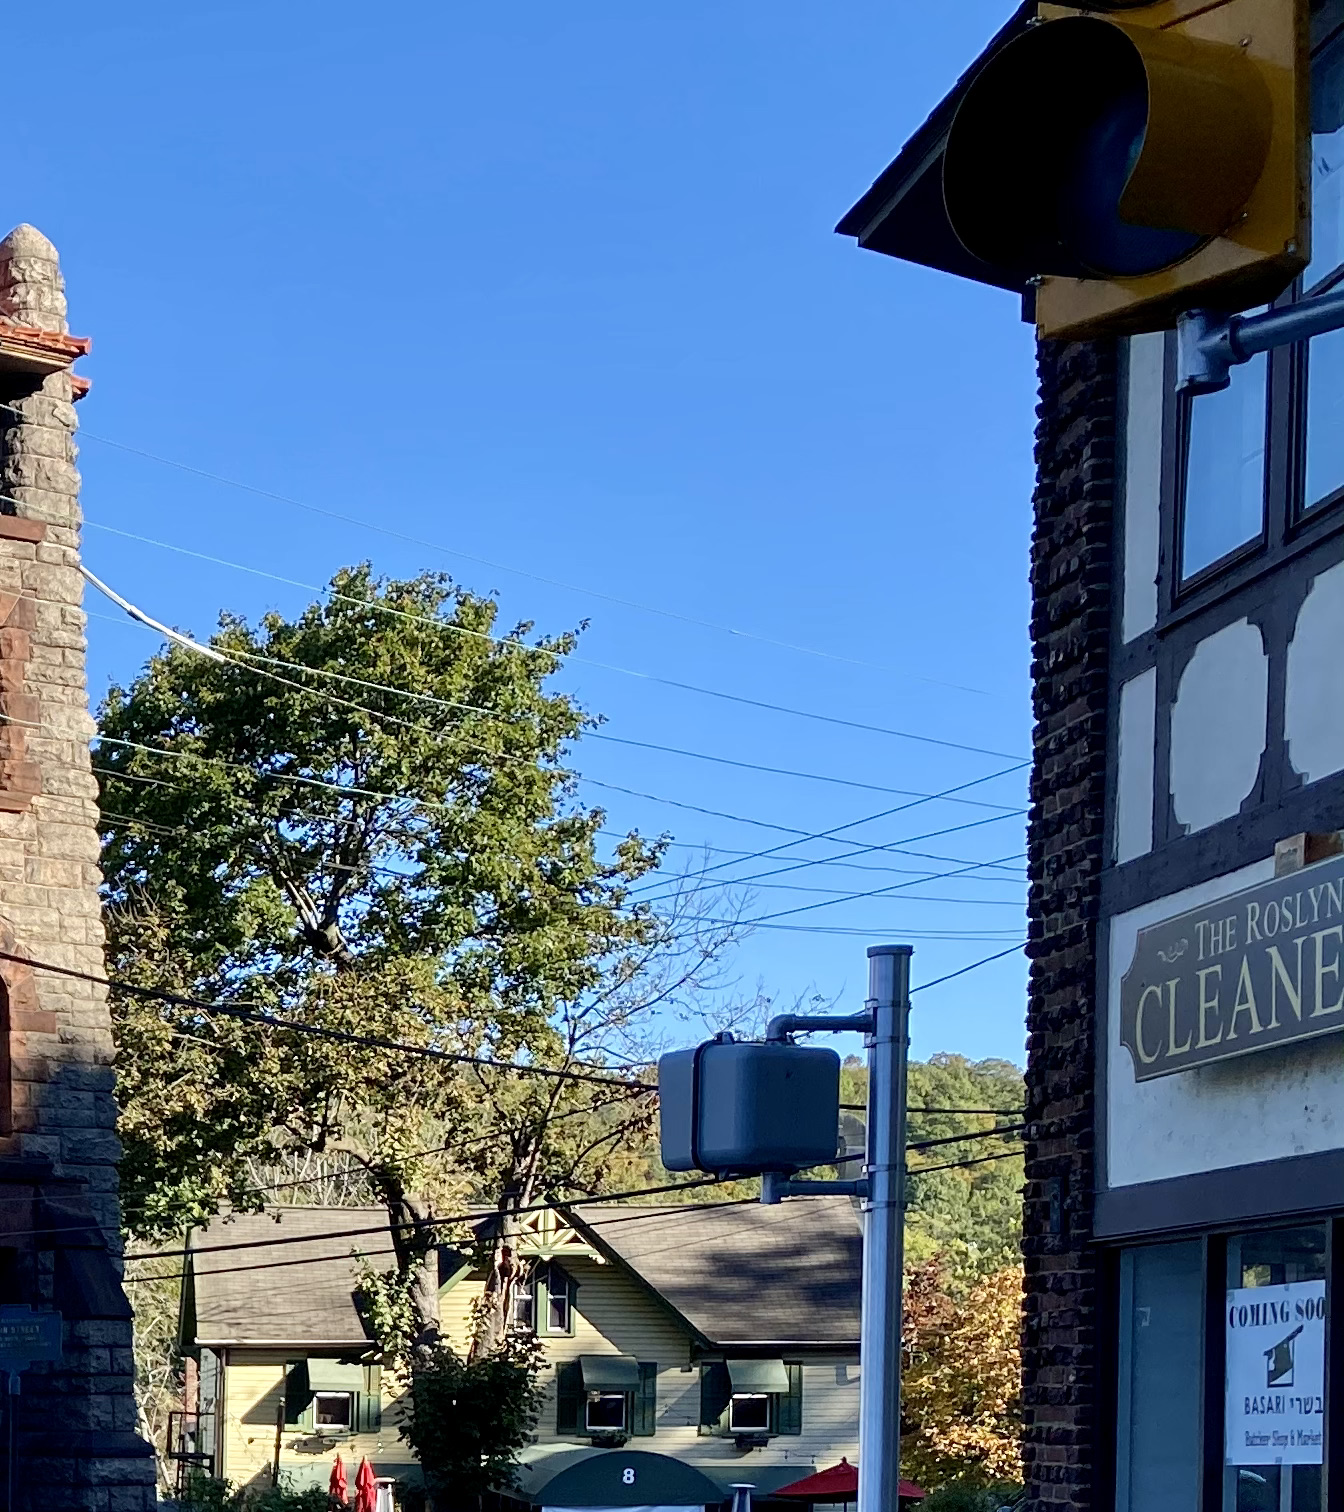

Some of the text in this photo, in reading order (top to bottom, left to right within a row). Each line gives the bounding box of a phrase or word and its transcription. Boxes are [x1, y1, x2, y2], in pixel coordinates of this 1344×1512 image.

[1194, 877, 1344, 961] THE ROSLYN
[1134, 925, 1344, 1064] CLEANE
[1229, 1300, 1290, 1328] COMING
[1244, 1395, 1284, 1414] BASARI
[622, 1468, 635, 1484] 8
